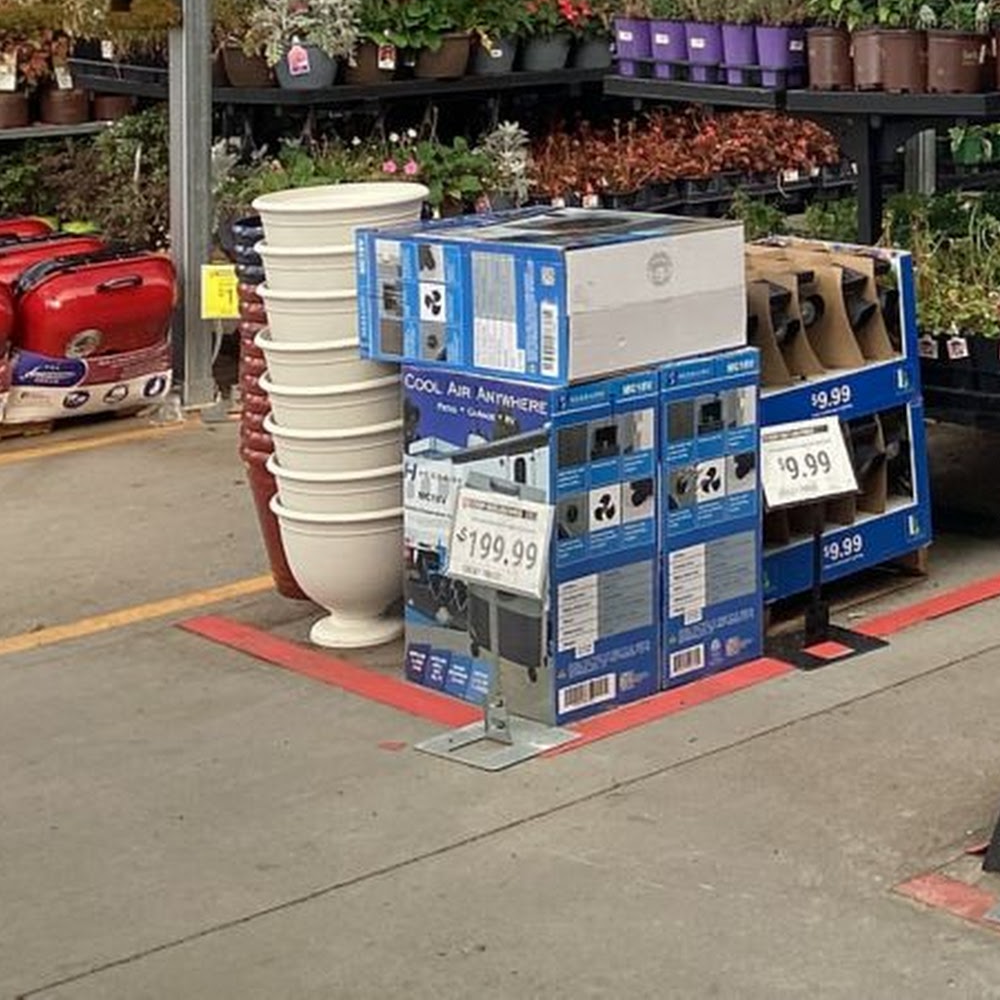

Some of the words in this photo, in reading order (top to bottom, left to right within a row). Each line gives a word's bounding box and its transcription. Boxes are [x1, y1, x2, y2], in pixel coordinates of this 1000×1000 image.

[403, 373, 443, 395] COOL
[446, 381, 471, 399] AIR
[811, 384, 851, 410] $9.99
[777, 450, 832, 480] $9.99
[456, 526, 538, 570] $199.99
[823, 534, 863, 560] $9.99
